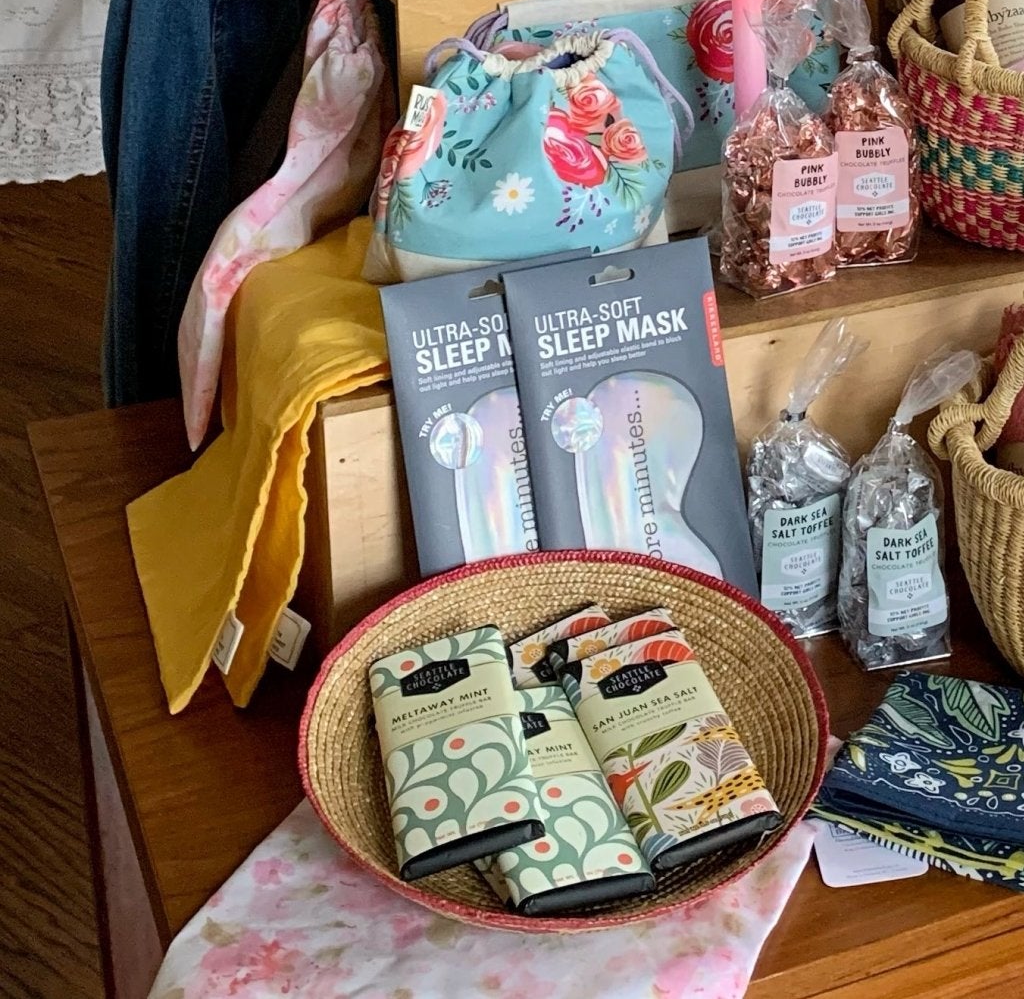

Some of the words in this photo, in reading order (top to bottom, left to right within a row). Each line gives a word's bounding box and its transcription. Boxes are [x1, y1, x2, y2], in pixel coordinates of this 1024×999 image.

[862, 136, 885, 146] PINK
[856, 148, 891, 159] BUBBLY
[801, 164, 825, 174] PINK
[794, 175, 828, 188] BUBBLY
[856, 183, 893, 191] CHOCOLATE
[777, 189, 814, 198] CHOCOLATE
[792, 210, 825, 221] CHOCOLATE
[797, 204, 821, 213] SEATTLE
[535, 296, 643, 334] ULTRA-SOFT
[412, 314, 506, 349] ULTRA-SO
[537, 323, 610, 360] SLEEP
[616, 307, 689, 344] MASK
[416, 337, 491, 375] SLEEP
[540, 360, 554, 370] Soft
[555, 357, 574, 367] lining
[574, 353, 587, 363] and
[588, 347, 620, 361] adjustable
[621, 343, 641, 354] elastic
[665, 335, 682, 345] block
[553, 365, 569, 376] light
[570, 361, 582, 371] and
[583, 358, 598, 370] help
[598, 357, 610, 367] you
[610, 353, 628, 365] sleep
[628, 350, 647, 361] better
[418, 376, 433, 385] Soft
[433, 373, 453, 382] lining
[454, 368, 467, 377] and
[467, 362, 501, 375] adjustable
[419, 385, 431, 393] out
[432, 380, 448, 391] light
[449, 377, 461, 387] and
[462, 375, 477, 385] help
[478, 373, 491, 384] you
[491, 368, 509, 380] sleep
[540, 402, 555, 423] TRY
[554, 387, 573, 404] ME!
[418, 417, 434, 439] TRY
[432, 403, 453, 419] ME!
[772, 528, 797, 539] SALT
[801, 516, 833, 535] TOFFEE
[780, 514, 808, 527] DARK
[811, 507, 827, 520] SEA
[767, 539, 808, 548] CHOCOLATE
[883, 537, 912, 548] DARK
[914, 528, 928, 543] SEA
[791, 552, 817, 563] SEATTLE
[875, 551, 901, 561] SALT
[906, 537, 934, 559] TOFFEE
[784, 558, 821, 570] CHOCOLATE
[871, 563, 913, 571] CHOCOLATE
[889, 582, 929, 594] CHOCOLATE
[896, 577, 924, 588] SEATTLE
[406, 667, 465, 691] CHOCOLATE
[413, 663, 456, 681] SEATTLE
[605, 669, 662, 695] CHOCOLATE
[609, 666, 650, 684] SEATTLE
[391, 697, 455, 724] MELTAWAY
[459, 688, 488, 702] MINT
[407, 708, 448, 725] CHOCOLATE
[450, 700, 476, 711] TRUFFLE
[592, 715, 615, 733] SAN
[618, 703, 649, 720] JUAN
[650, 694, 670, 707] SEA
[673, 686, 698, 699] SALT
[601, 724, 617, 734] MILK
[618, 707, 656, 726] CHOCOLATE
[657, 700, 682, 714] TRUFFLE
[621, 722, 636, 732] with
[662, 706, 682, 715] toffee
[545, 743, 573, 753] MINT
